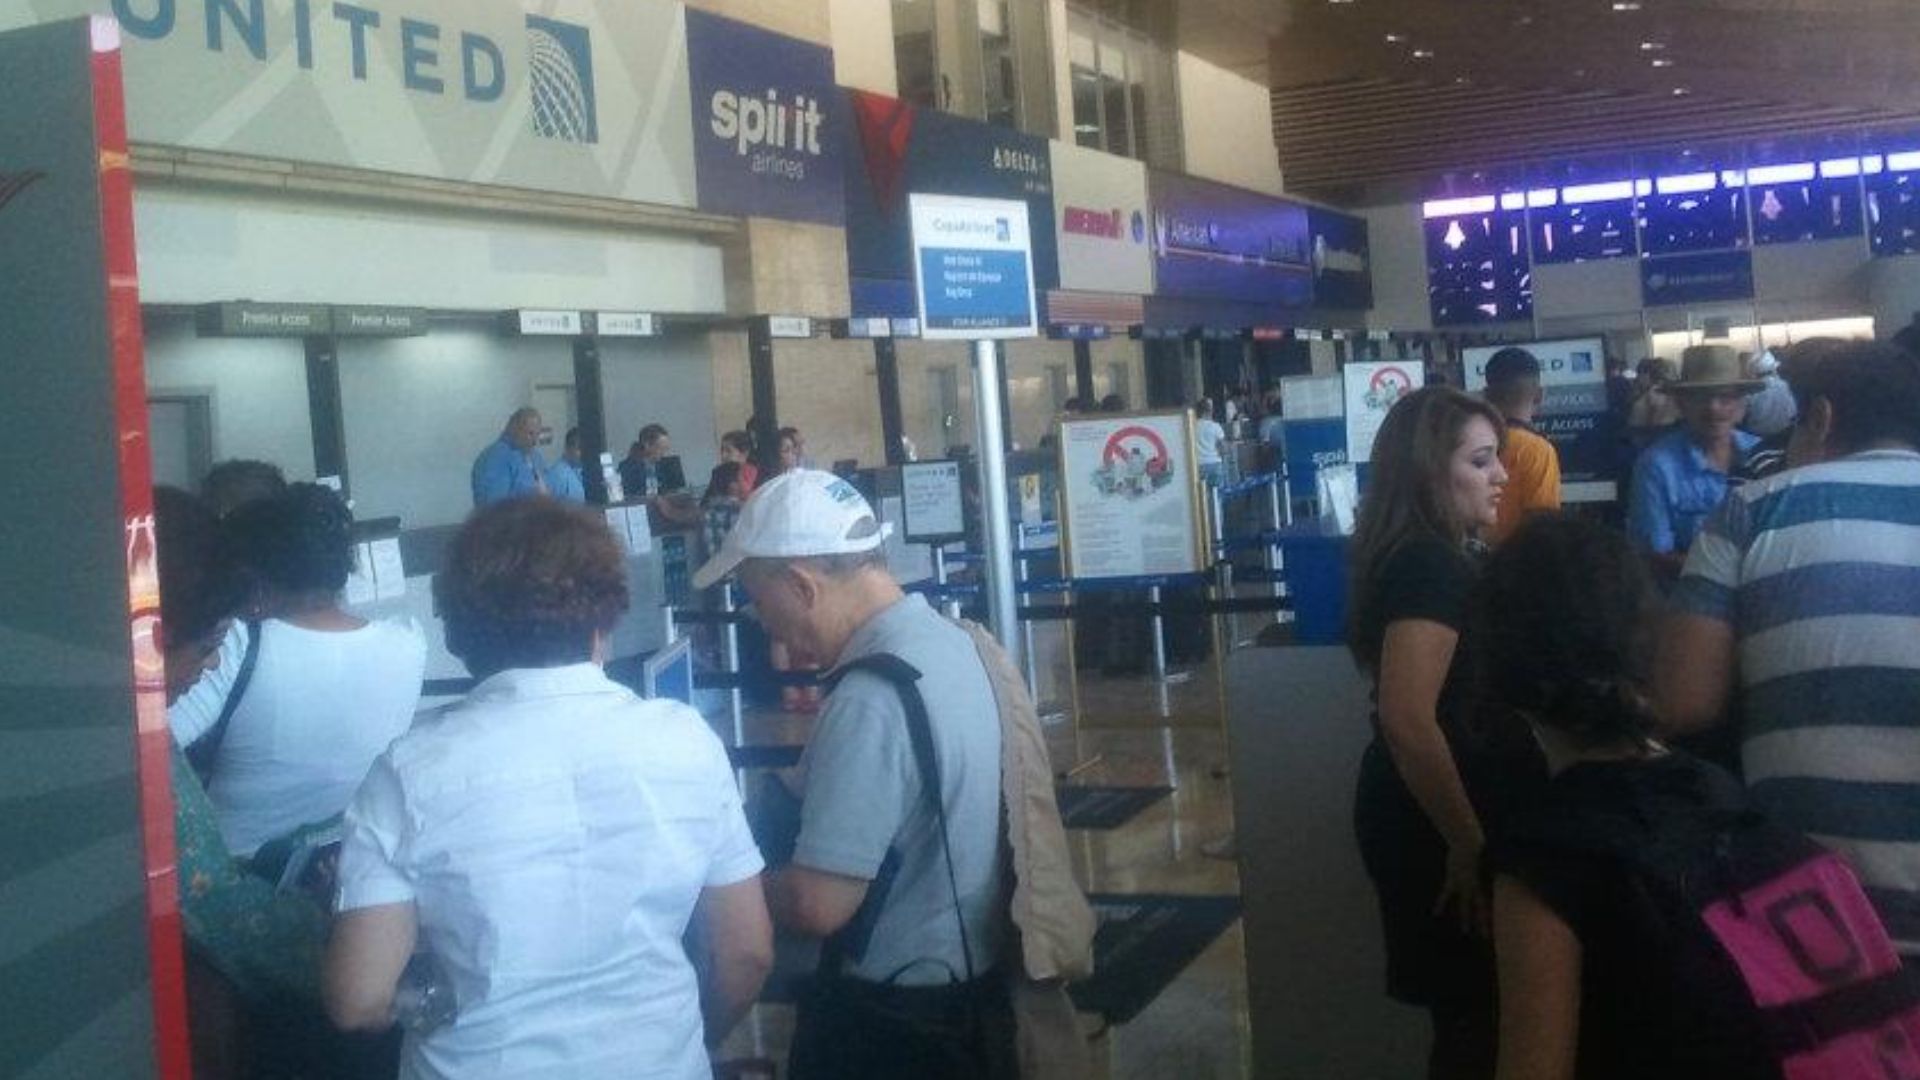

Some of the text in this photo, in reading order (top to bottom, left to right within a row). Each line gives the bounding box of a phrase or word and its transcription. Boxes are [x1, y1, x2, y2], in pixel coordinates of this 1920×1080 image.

[111, 0, 507, 103] UNITED
[711, 88, 825, 156] spirit
[1003, 148, 1039, 175] DELTA
[242, 310, 279, 328] Premier
[351, 309, 385, 328] Premier
